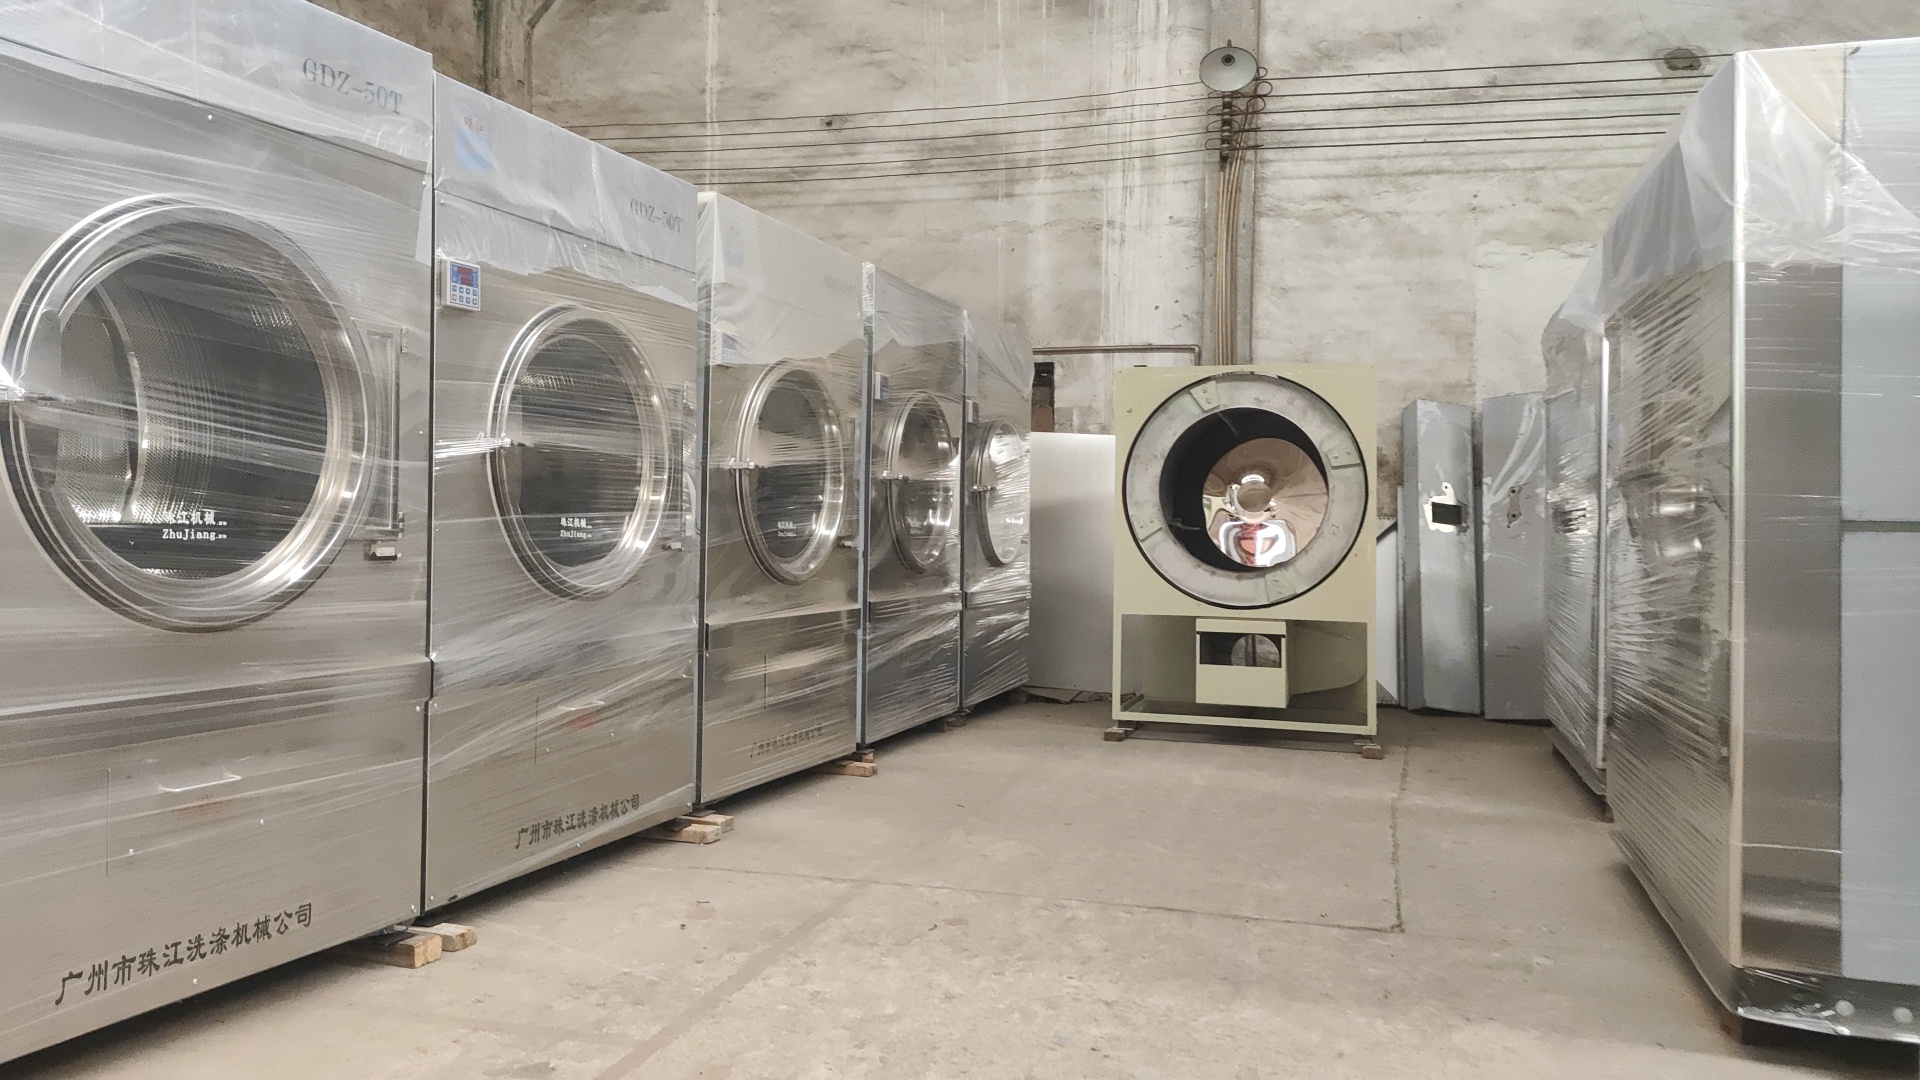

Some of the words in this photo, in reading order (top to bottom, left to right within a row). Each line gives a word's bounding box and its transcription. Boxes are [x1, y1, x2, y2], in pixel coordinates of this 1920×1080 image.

[303, 57, 402, 114] GDZ-50T
[630, 198, 683, 233] GDZ-50T
[162, 528, 216, 541] ZhuJiang
[514, 793, 640, 850] 广州市珠江洗涤机械公司
[54, 902, 313, 1006] 广州市珠江洗涤机械公司
